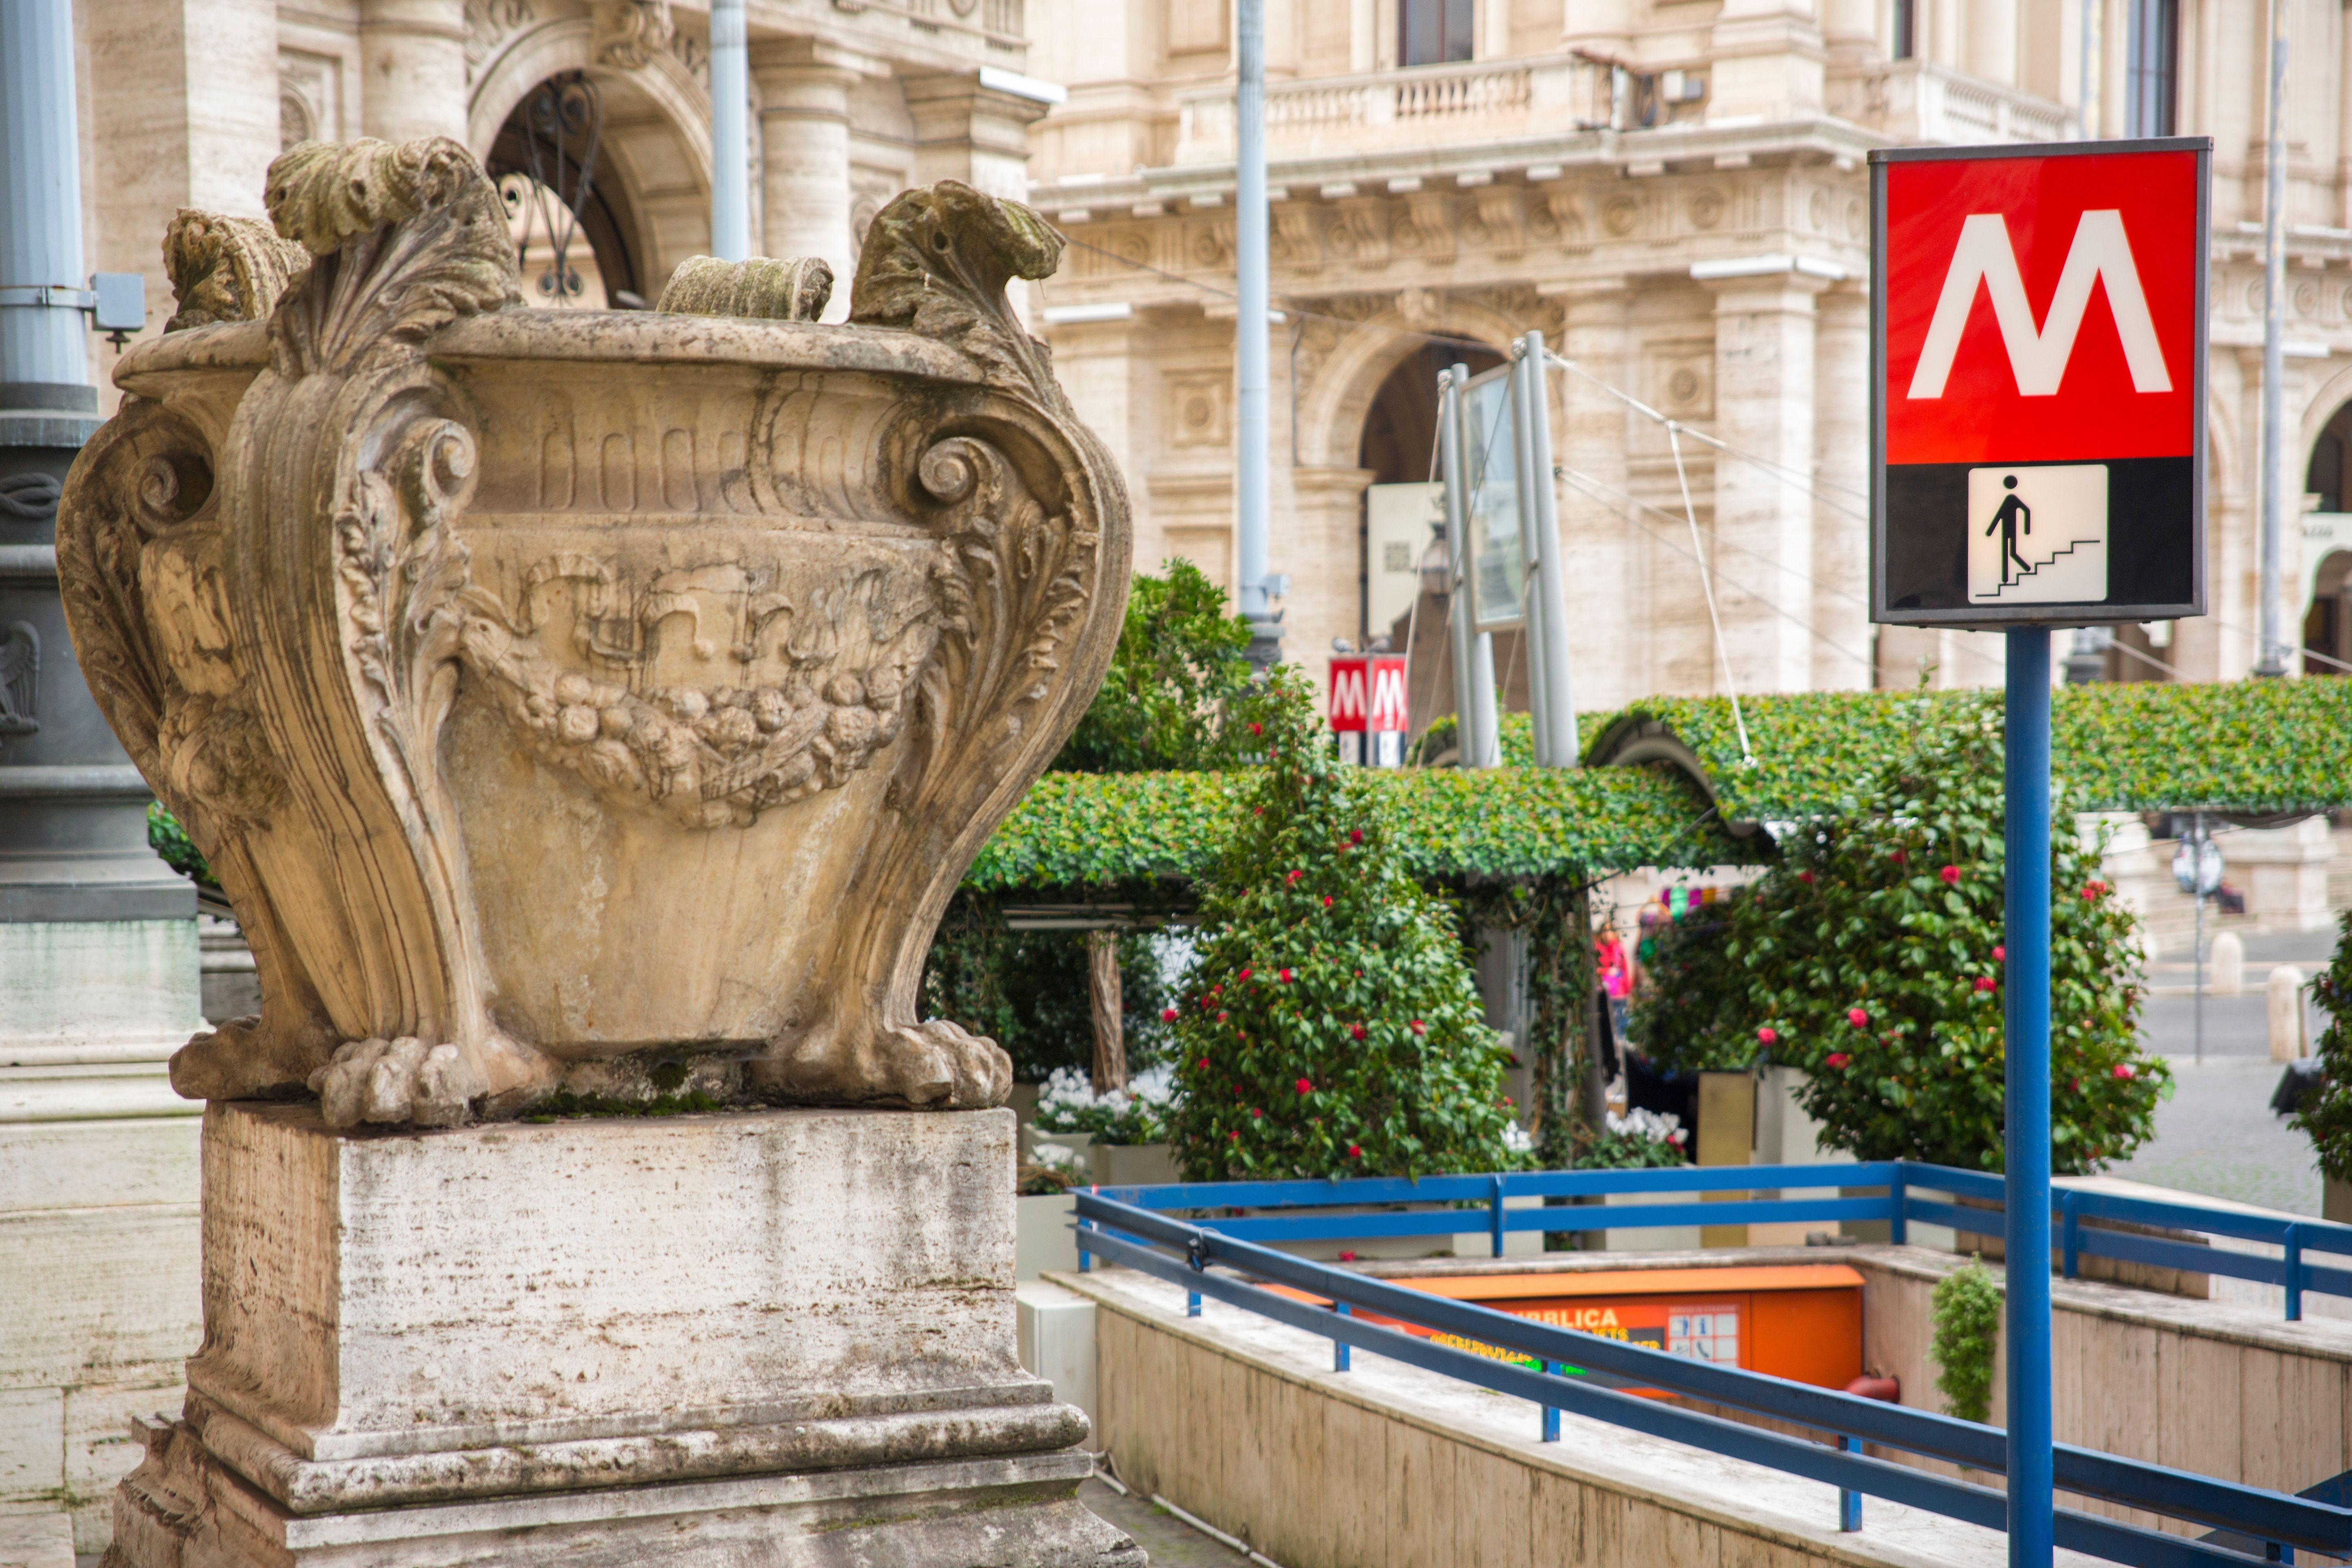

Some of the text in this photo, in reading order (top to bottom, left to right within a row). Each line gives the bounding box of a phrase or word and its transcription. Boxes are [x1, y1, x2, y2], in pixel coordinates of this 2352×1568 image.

[1906, 209, 2174, 399] M
[1331, 669, 1367, 719] M
[1372, 668, 1407, 719] M
